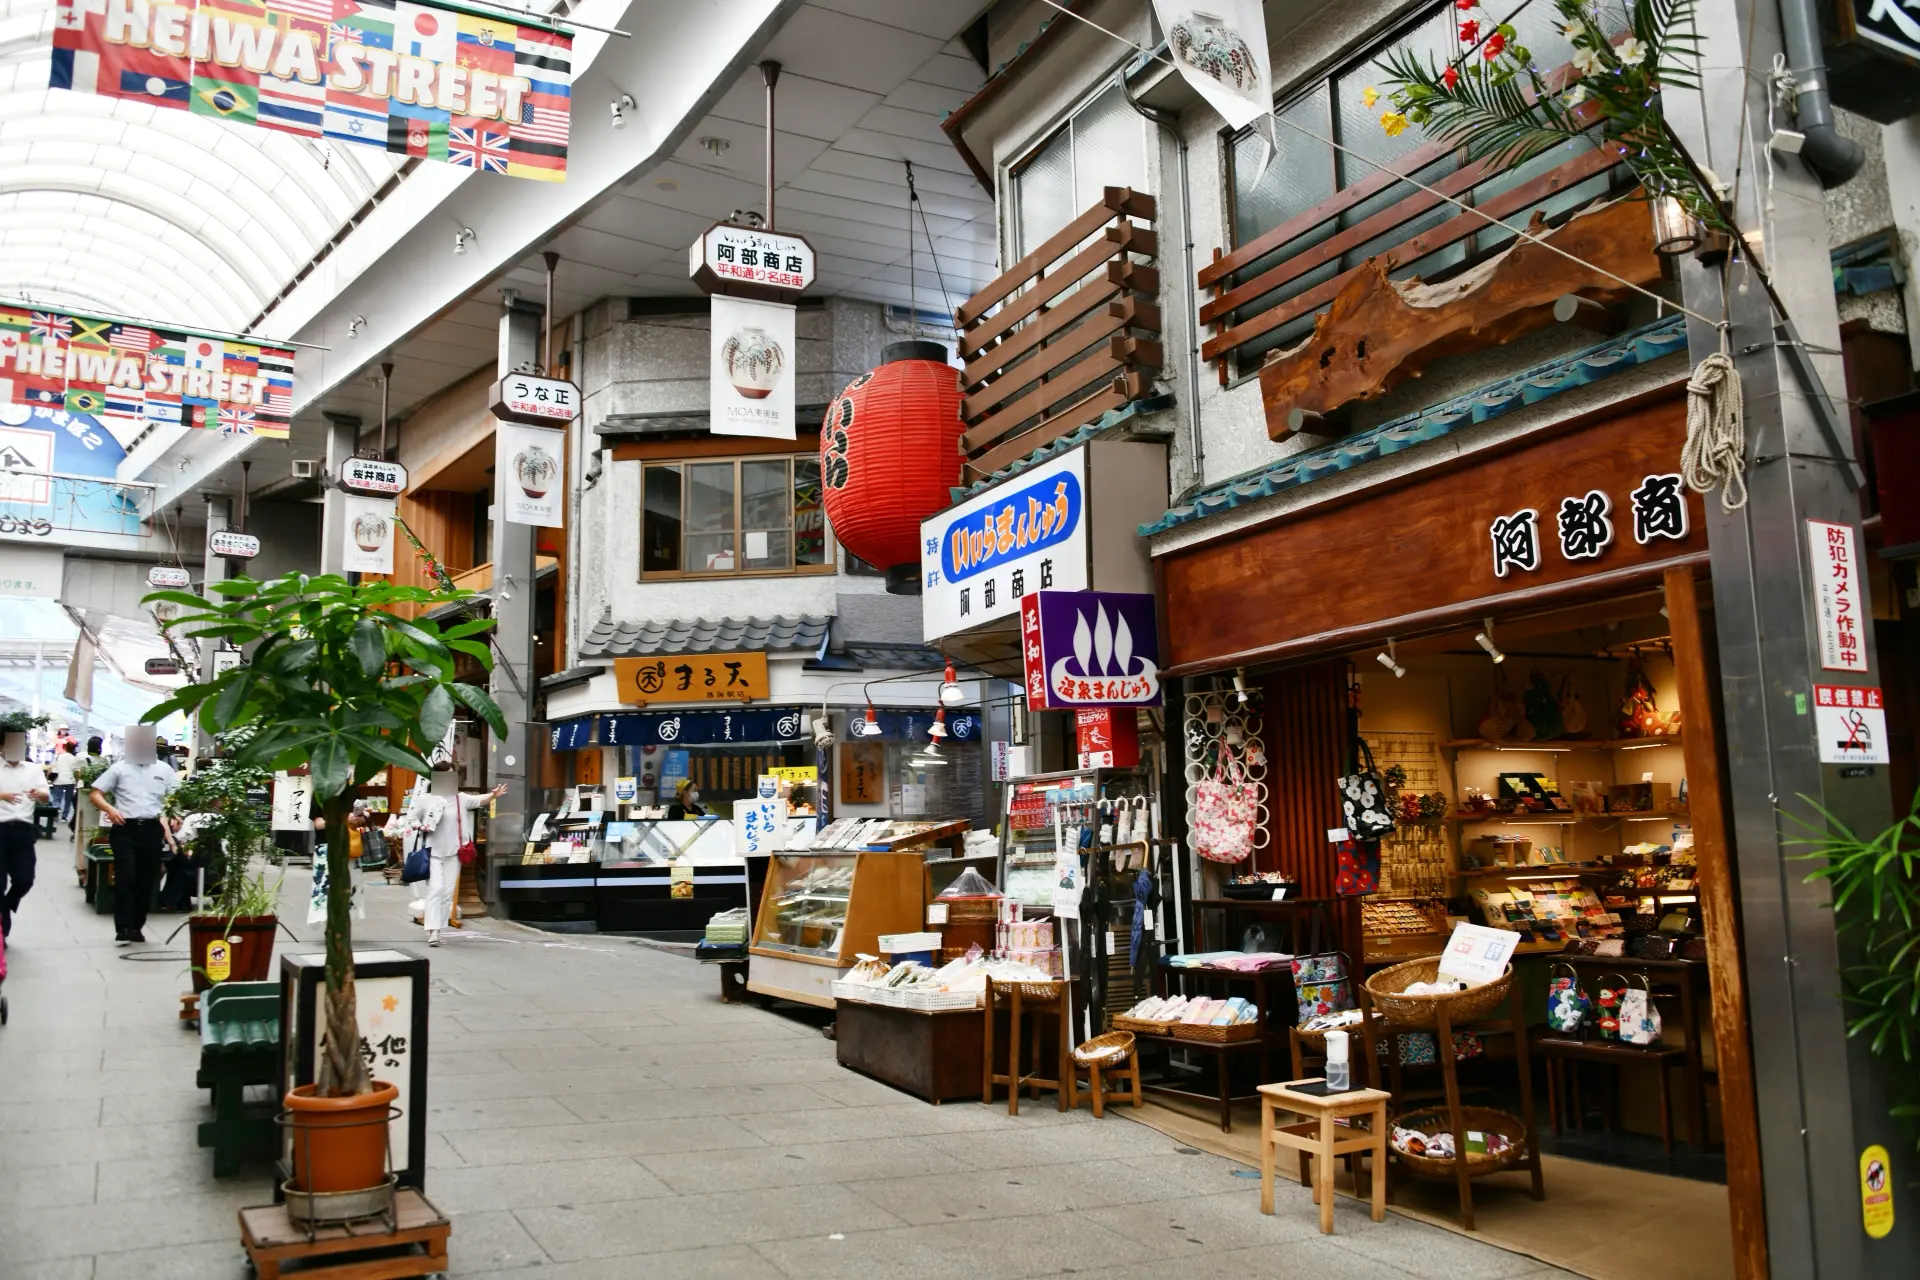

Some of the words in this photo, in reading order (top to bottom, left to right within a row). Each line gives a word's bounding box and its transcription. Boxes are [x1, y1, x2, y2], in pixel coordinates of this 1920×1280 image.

[103, 0, 322, 84] HEIWA
[331, 40, 532, 125] STREET
[717, 243, 803, 273] 阿部商店
[717, 262, 804, 287] 平和通り名店街
[15, 342, 143, 390] HEIWA
[148, 361, 269, 405] STREET
[514, 382, 570, 405] うな正
[511, 401, 573, 418] 平和通り名店街
[353, 468, 397, 484] 桜井商店
[951, 480, 1070, 575] いいらまんじゅう
[1490, 473, 1690, 578] 阿部商
[926, 537, 940, 588] 特許
[0, 577, 37, 591] ります。
[959, 558, 1054, 618] 阿部商店
[1826, 526, 1858, 667] 防犯カメラ作動中
[1024, 608, 1044, 702] 正和堂
[674, 661, 750, 691] まる天
[1057, 675, 1151, 700] 温泉まんじゅう
[1818, 687, 1880, 708] 喫煙禁止
